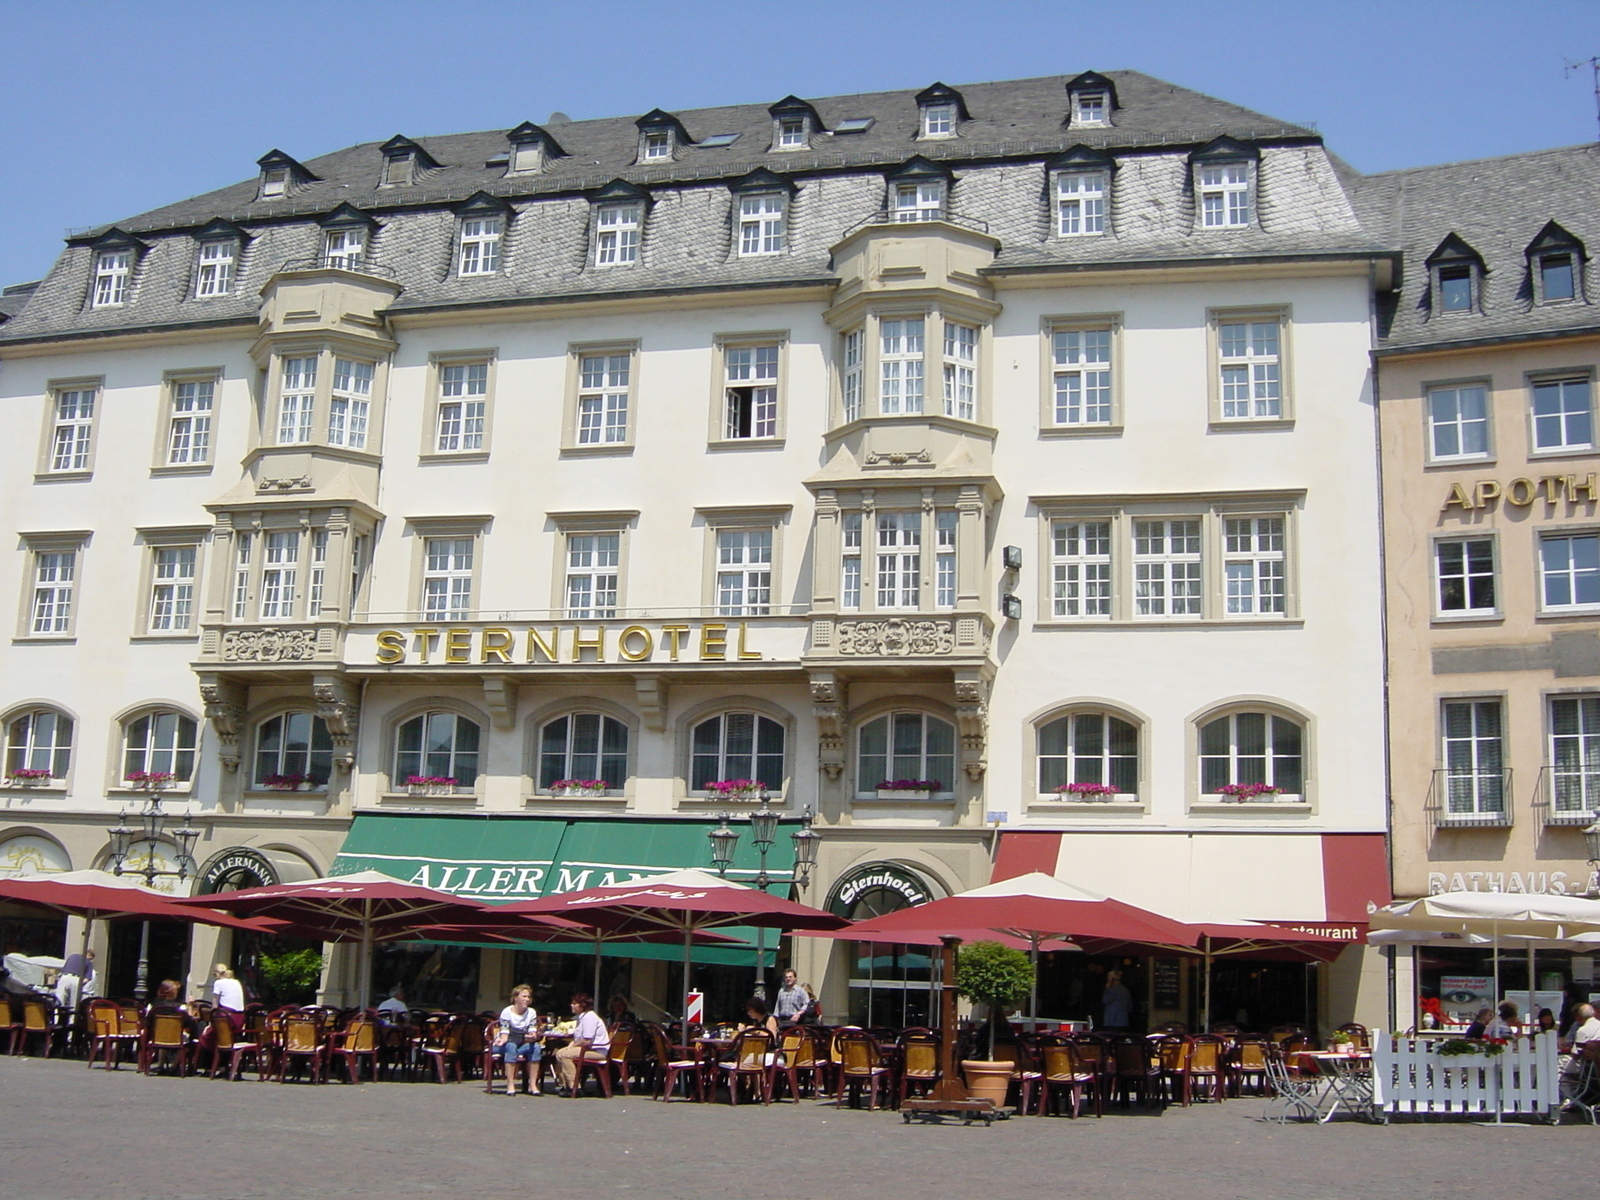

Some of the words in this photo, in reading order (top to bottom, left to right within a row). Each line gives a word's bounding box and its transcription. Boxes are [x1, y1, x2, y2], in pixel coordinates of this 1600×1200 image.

[1440, 472, 1598, 511] APOTH
[375, 622, 762, 664] STERNHOTEL
[207, 857, 273, 887] ALLERMANN
[408, 864, 543, 895] ALLER
[839, 871, 924, 905] Sternhotel
